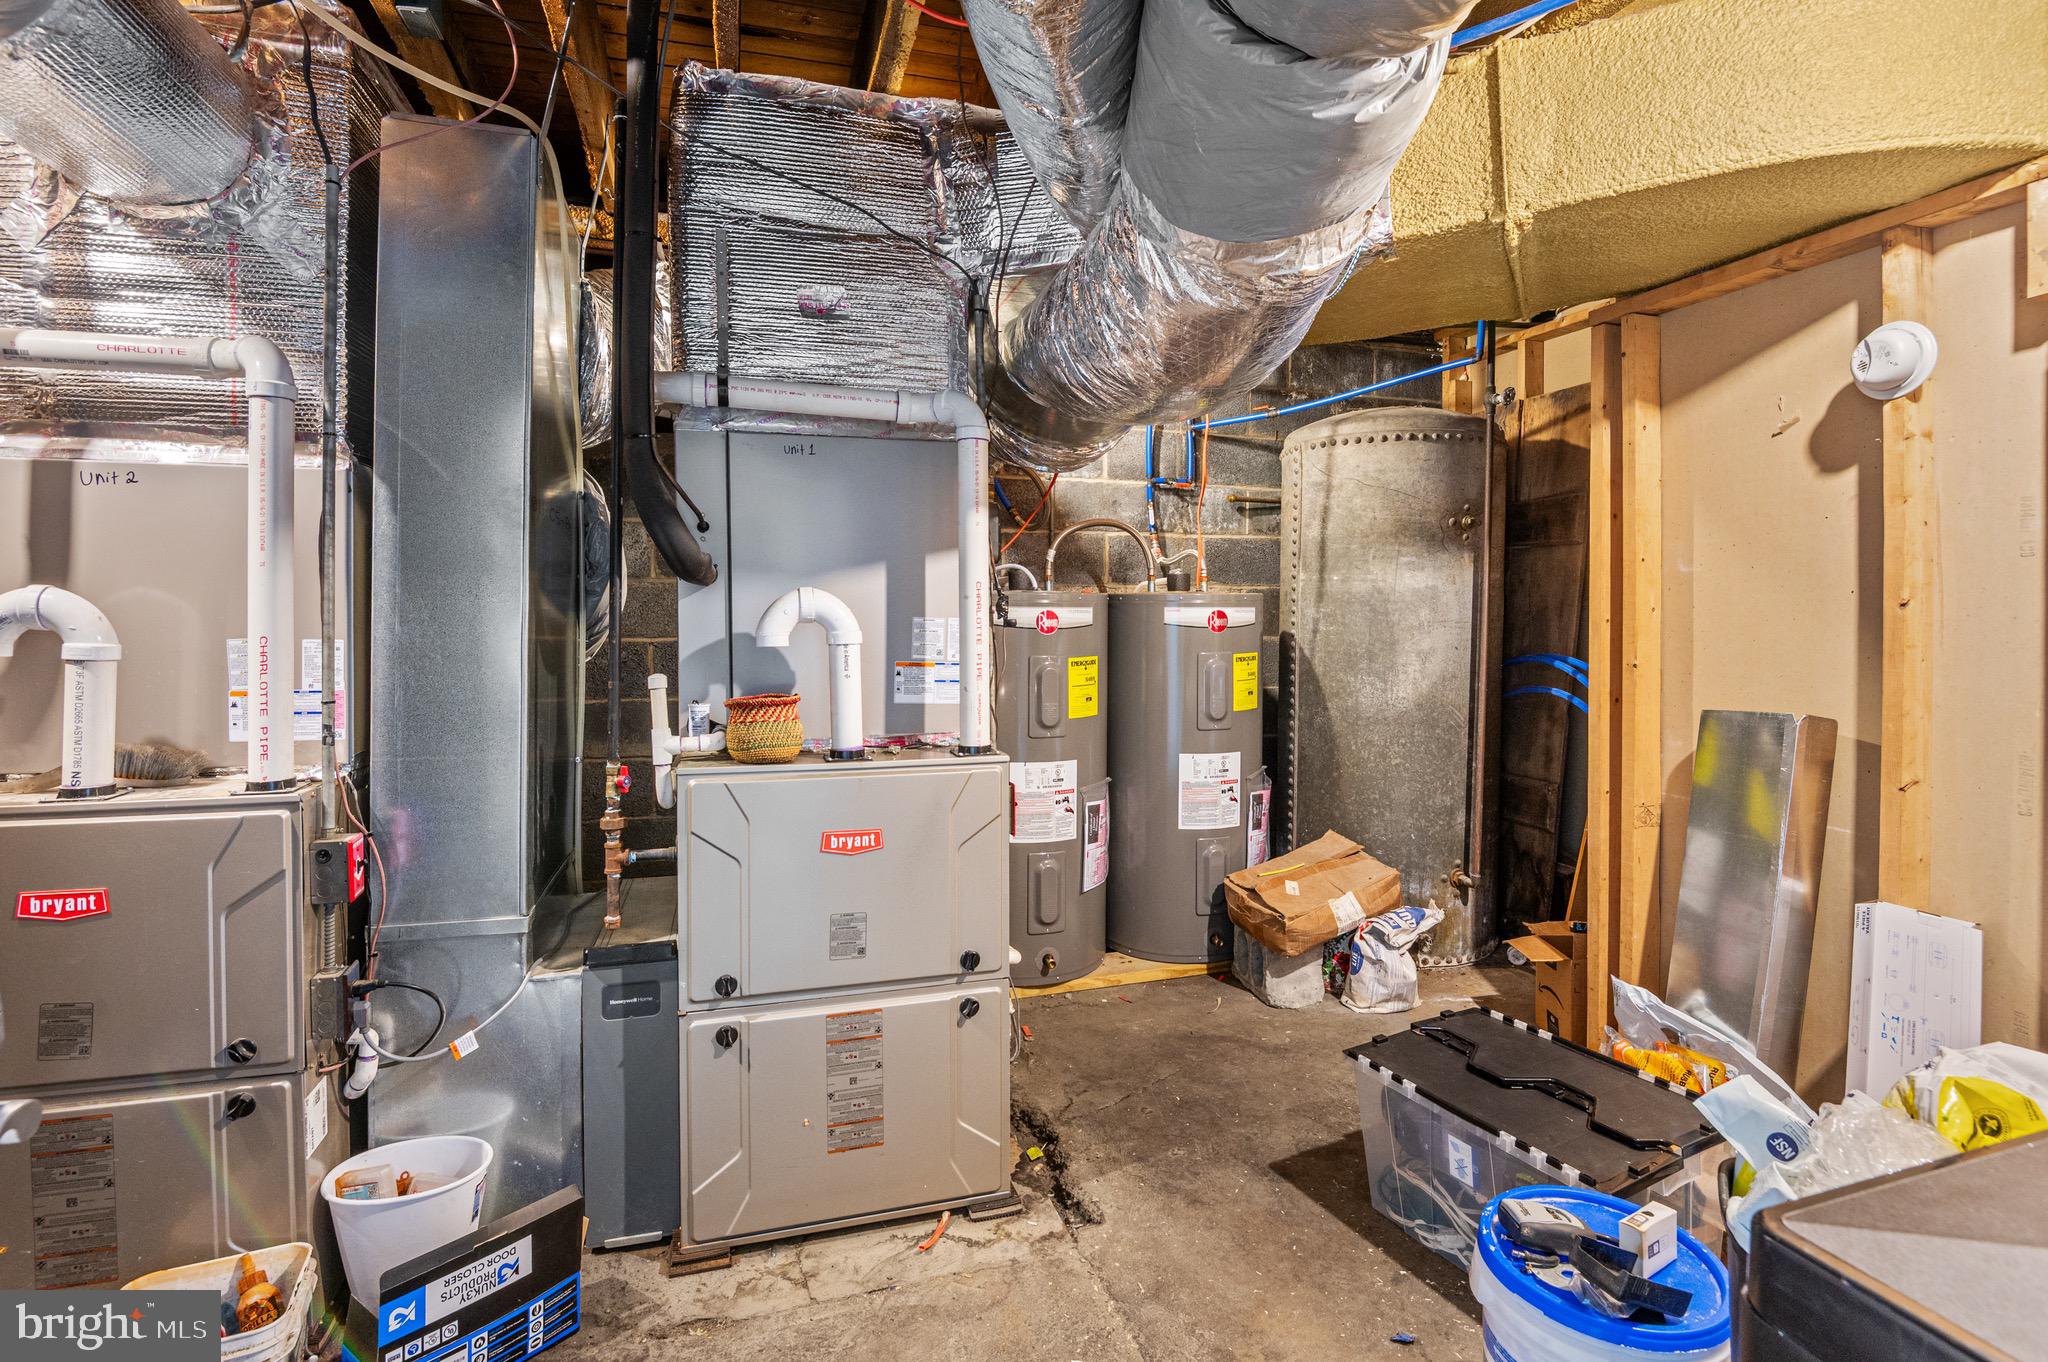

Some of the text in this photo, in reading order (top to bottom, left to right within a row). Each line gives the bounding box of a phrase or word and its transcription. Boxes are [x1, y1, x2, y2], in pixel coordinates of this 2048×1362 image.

[96, 343, 187, 356] CHARLOTTE
[808, 444, 816, 455] 1
[80, 470, 139, 487] Unit 2
[975, 581, 983, 645] CHARLOTTE
[259, 636, 269, 717] CHARLOTTE
[74, 680, 85, 701] ASTM
[74, 702, 84, 724] D2665
[73, 725, 83, 746] ASTM
[73, 747, 83, 768] D1785
[830, 833, 876, 851] bryant
[30, 894, 97, 915] bryant
[609, 997, 638, 1005] Honeywell
[1769, 1137, 1797, 1160] NSF
[443, 1246, 517, 1287] DOOR CLOSER
[440, 1267, 497, 1302] PRODUCTS
[459, 1278, 497, 1305] NUK3Y
